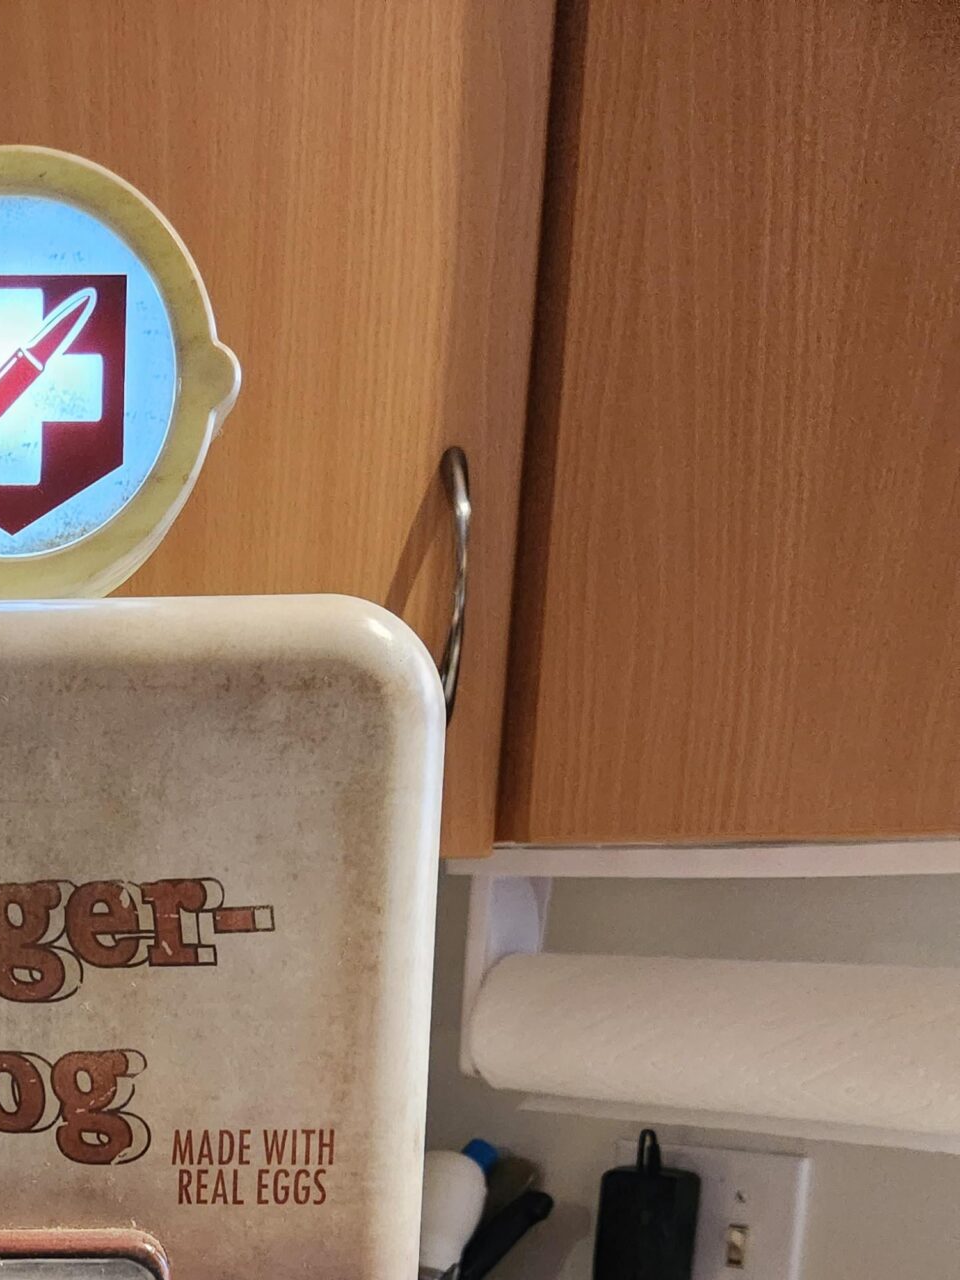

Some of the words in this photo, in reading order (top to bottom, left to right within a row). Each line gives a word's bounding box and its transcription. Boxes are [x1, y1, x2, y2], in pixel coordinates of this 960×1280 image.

[171, 1128, 252, 1166] MADE
[262, 1128, 336, 1166] WITH
[177, 1168, 245, 1206] REAL
[256, 1168, 328, 1206] EGGS
